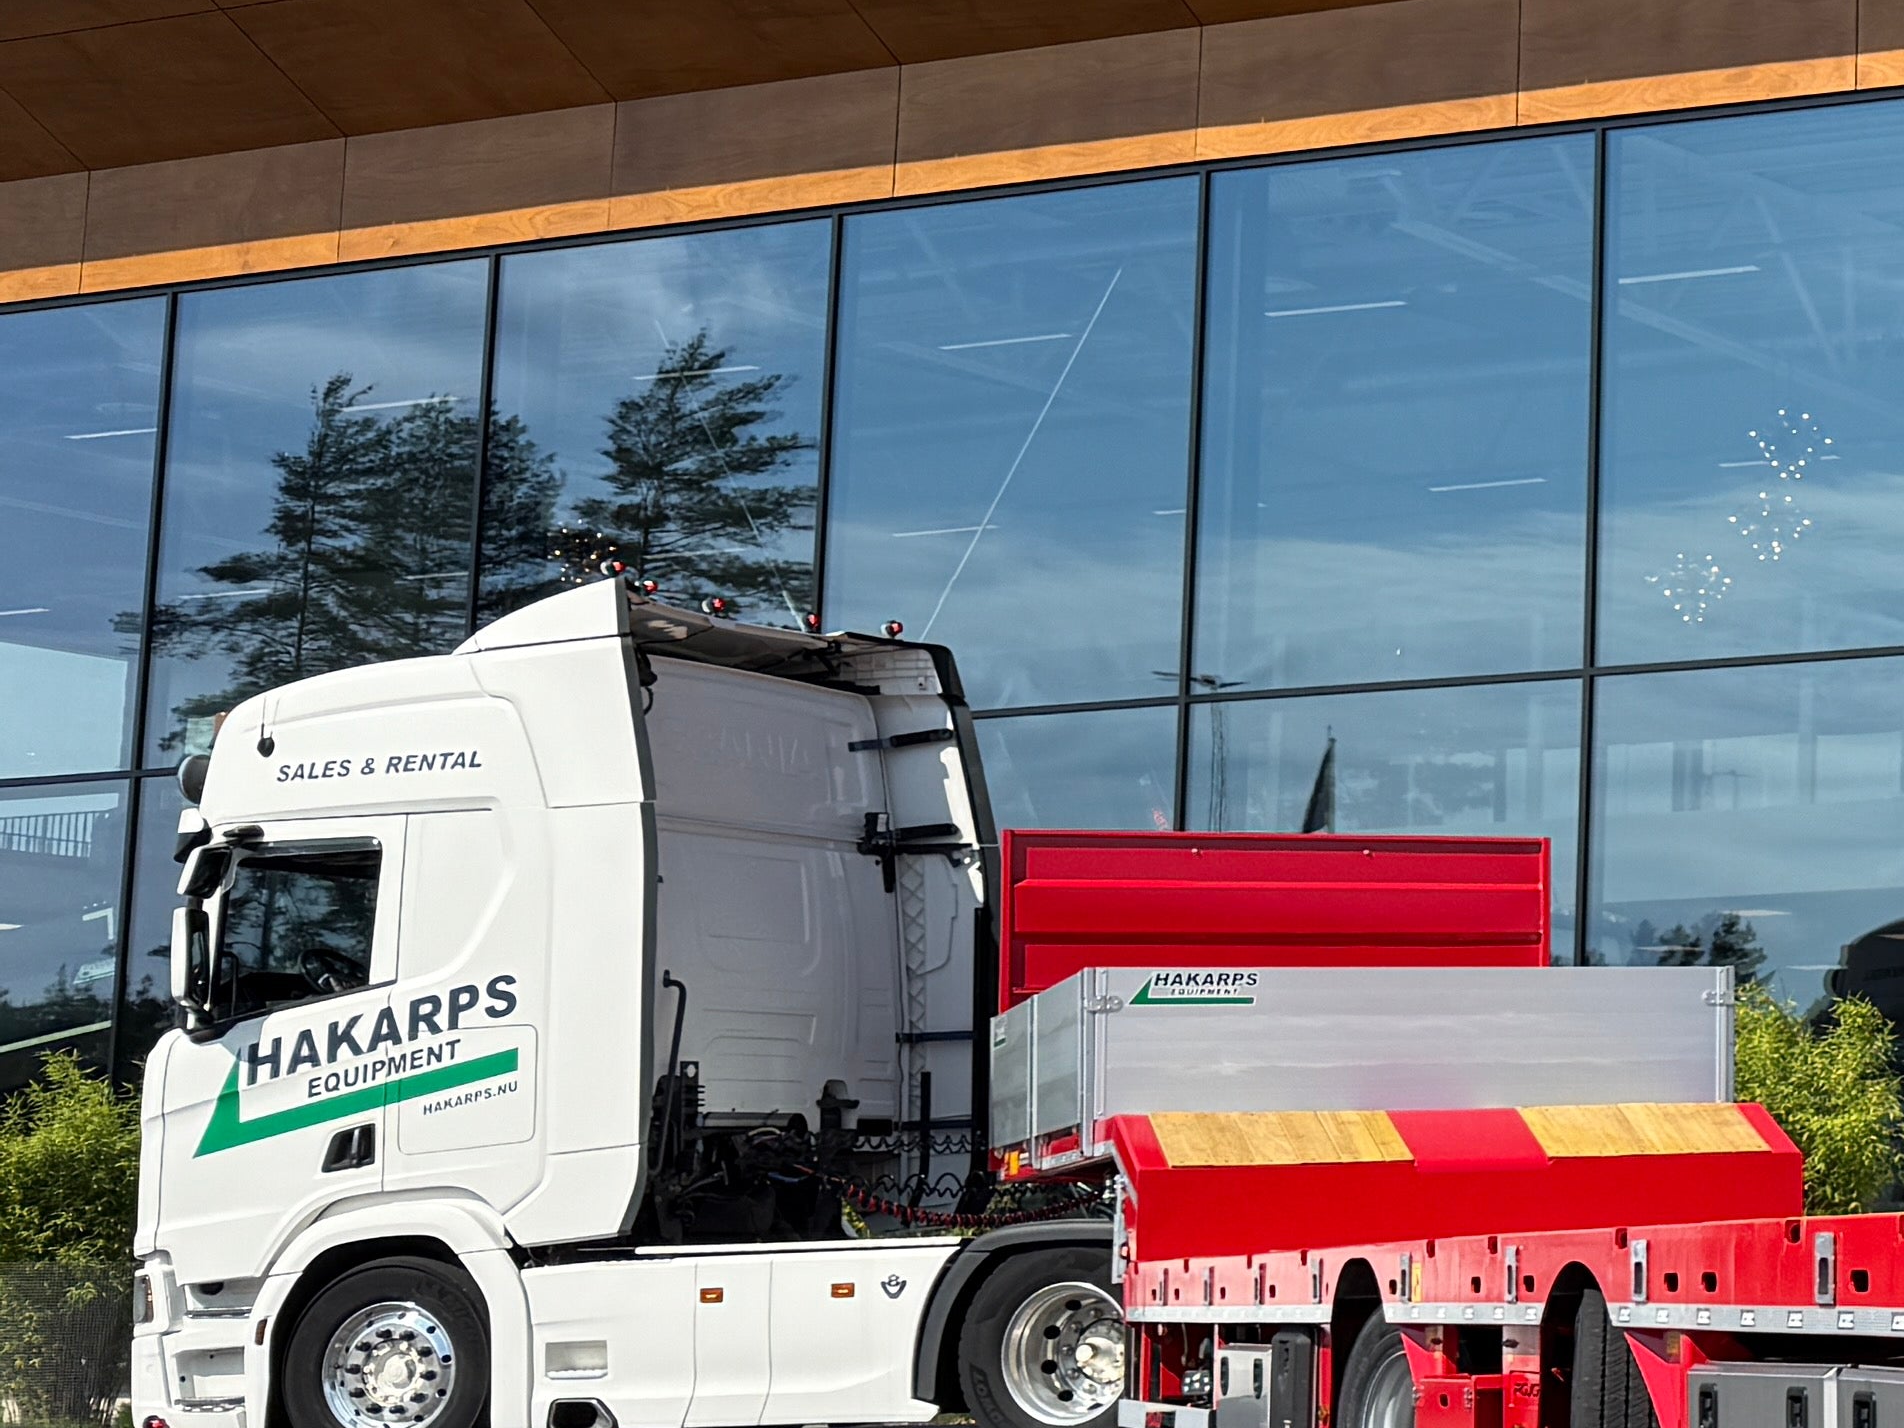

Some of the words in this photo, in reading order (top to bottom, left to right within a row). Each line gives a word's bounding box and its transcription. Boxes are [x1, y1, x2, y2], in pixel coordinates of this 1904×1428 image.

[276, 759, 351, 783] SALES
[360, 756, 377, 776] &
[385, 750, 482, 774] RENTAL
[1154, 973, 1258, 986] HAKARPS
[246, 974, 518, 1086] HAKARPS
[306, 1039, 462, 1099] EQUIPMENT
[423, 1081, 518, 1116] HAKARPS.NU
